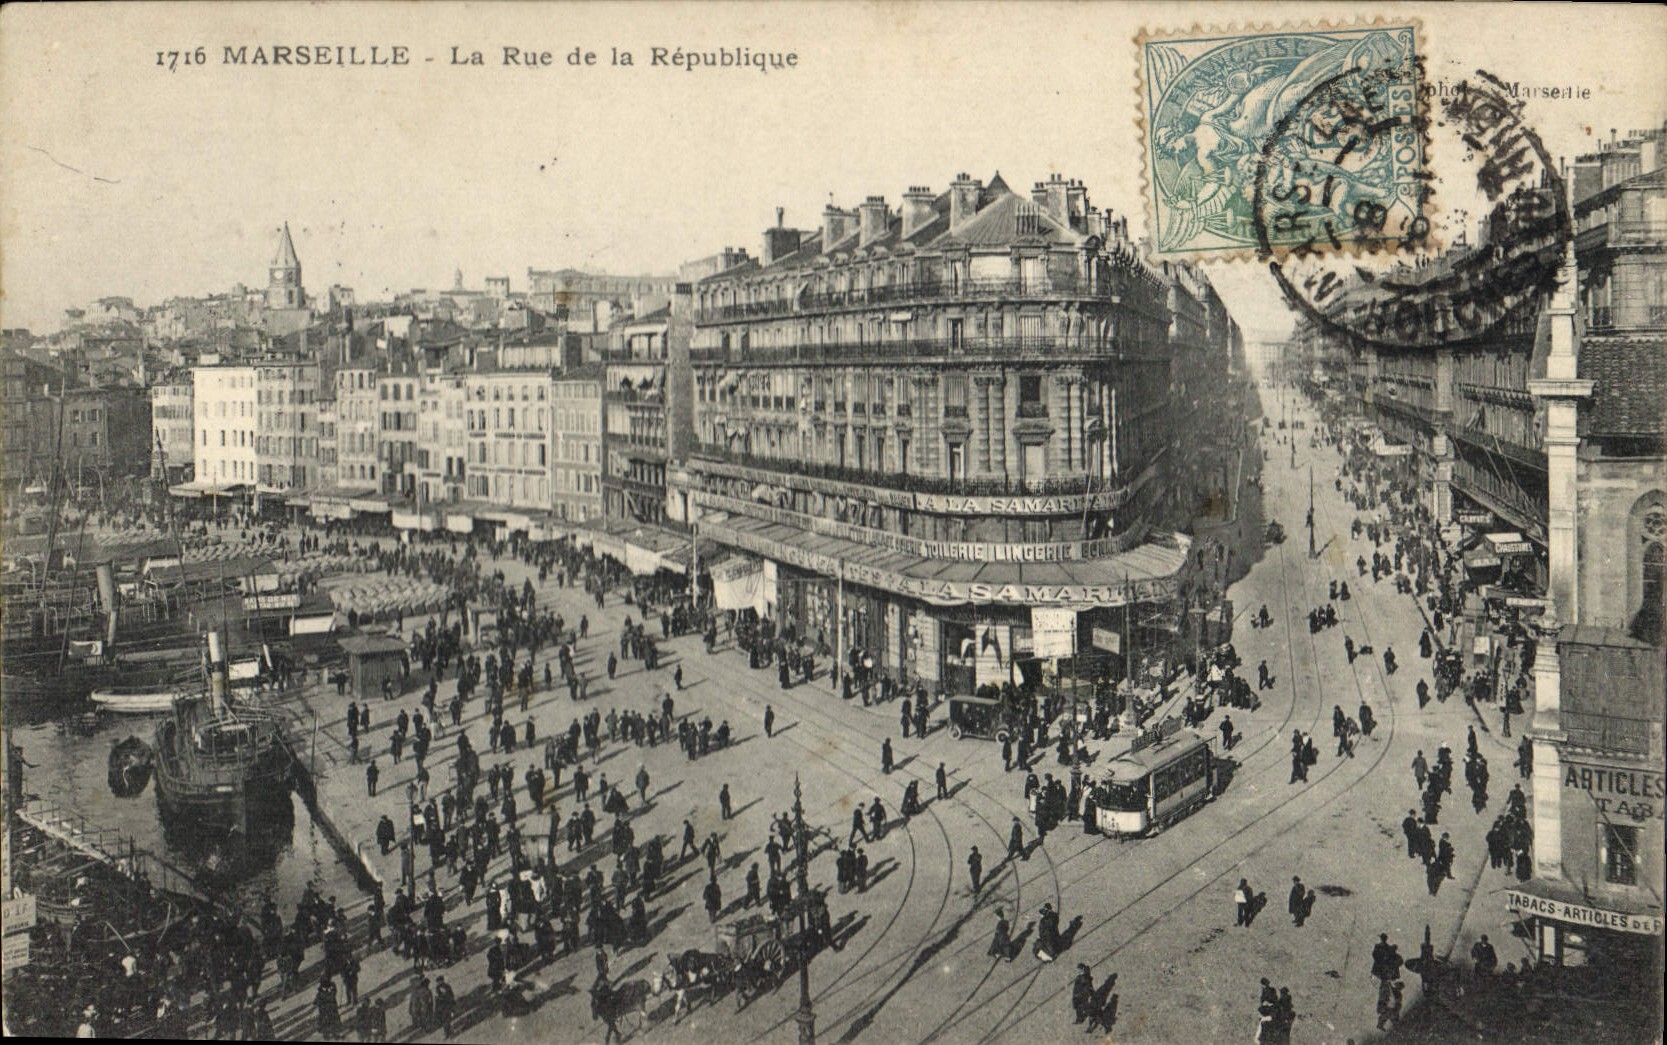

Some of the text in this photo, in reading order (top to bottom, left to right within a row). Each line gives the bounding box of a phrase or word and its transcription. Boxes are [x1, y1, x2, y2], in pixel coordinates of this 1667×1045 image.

[1391, 88, 1416, 181] POSTES
[945, 497, 982, 513] LA
[993, 543, 1073, 562] LINGERIE
[1495, 542, 1534, 554] CHAUSSURES
[918, 579, 966, 600] LA
[1564, 764, 1665, 799] ARTICLES
